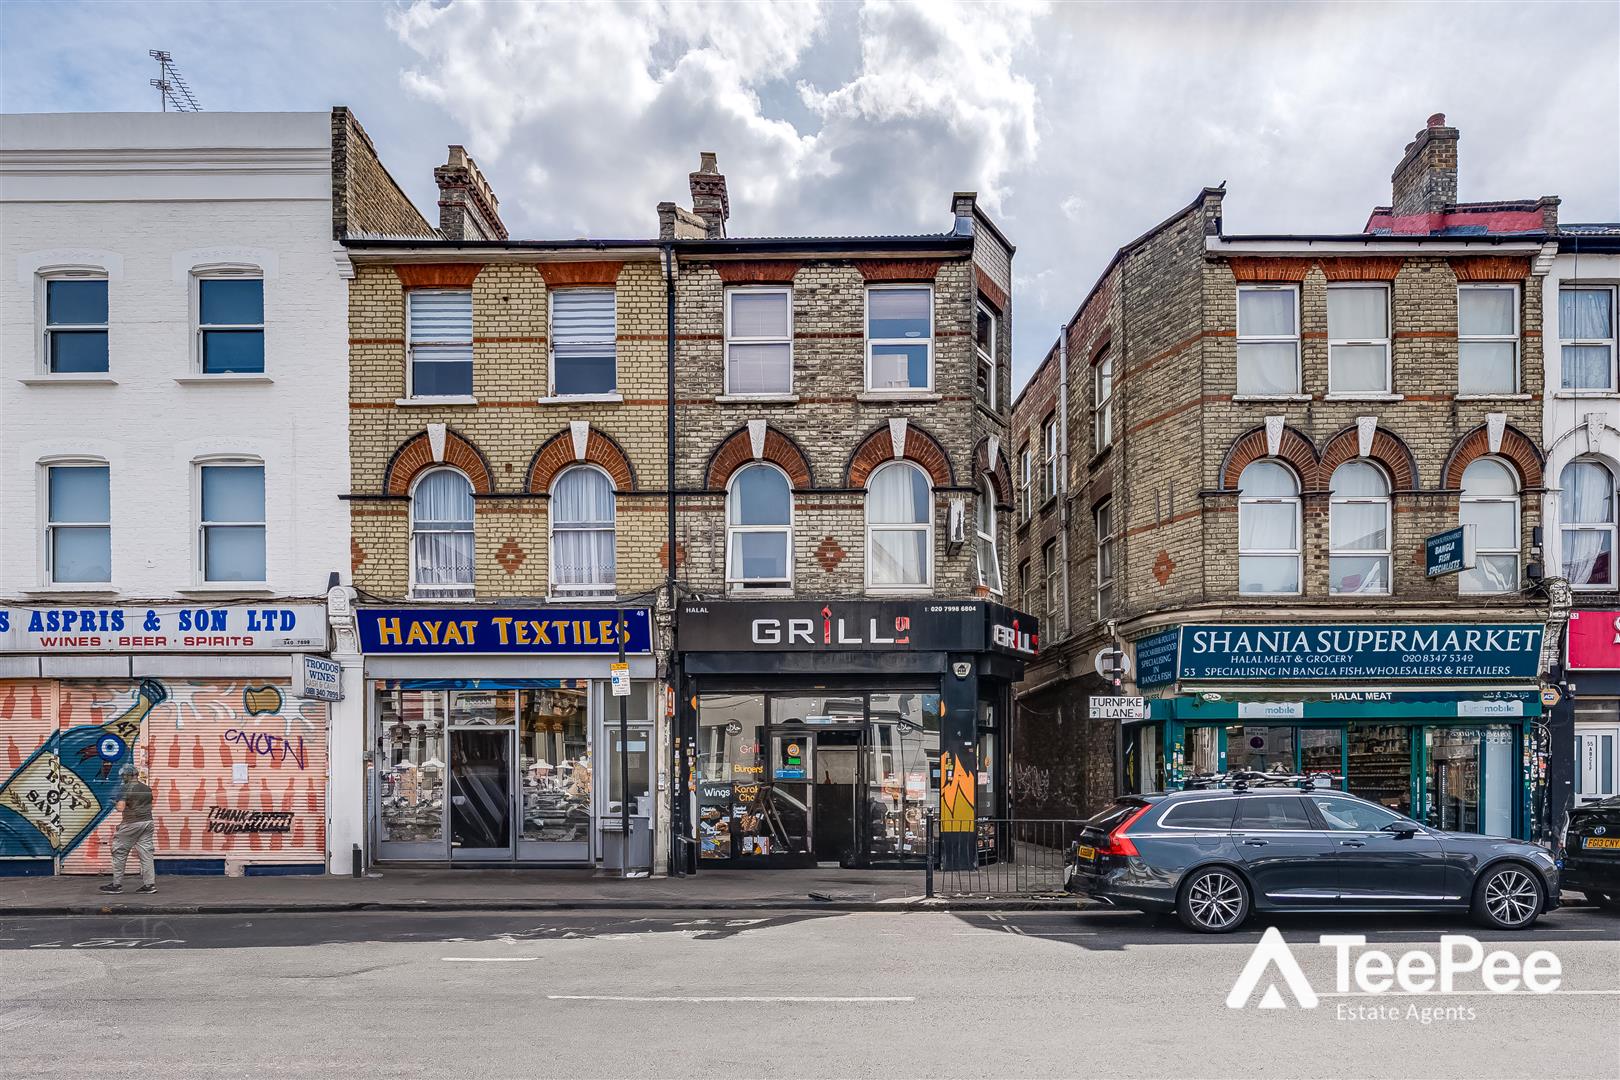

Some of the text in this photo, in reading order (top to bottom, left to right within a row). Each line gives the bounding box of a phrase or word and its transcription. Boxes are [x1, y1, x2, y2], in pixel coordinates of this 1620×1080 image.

[28, 610, 125, 632] ASPRIS
[143, 610, 161, 632] &
[179, 609, 228, 631] SON
[247, 610, 296, 631] LTD
[377, 617, 630, 645] HAYAT TEXTILES
[40, 636, 254, 646] WINES BEER SPIRITS
[1193, 630, 1541, 653] SHANIA SUPERMARKET
[1231, 655, 1354, 664] HALAL MEAT & GROCERY
[1402, 654, 1474, 662] 020 8347 5342
[306, 659, 339, 673] TROODOS
[1205, 667, 1276, 676] SPECIALISING
[1278, 667, 1291, 675] IN
[1293, 667, 1337, 675] BANGLA
[1366, 666, 1443, 675] WHOLESALERS
[1444, 666, 1453, 674] &
[1455, 666, 1510, 675] RETAILERS
[309, 670, 336, 682] WINES
[1184, 668, 1196, 677] 53
[1331, 692, 1392, 700] HALAL MEAT
[1091, 697, 1142, 706] TURNPIKE
[1106, 708, 1134, 717] LANE
[734, 764, 763, 774] Burgers
[704, 787, 730, 798] Wings
[207, 805, 249, 822] THANK
[1588, 839, 1619, 848] FG13 CNY
